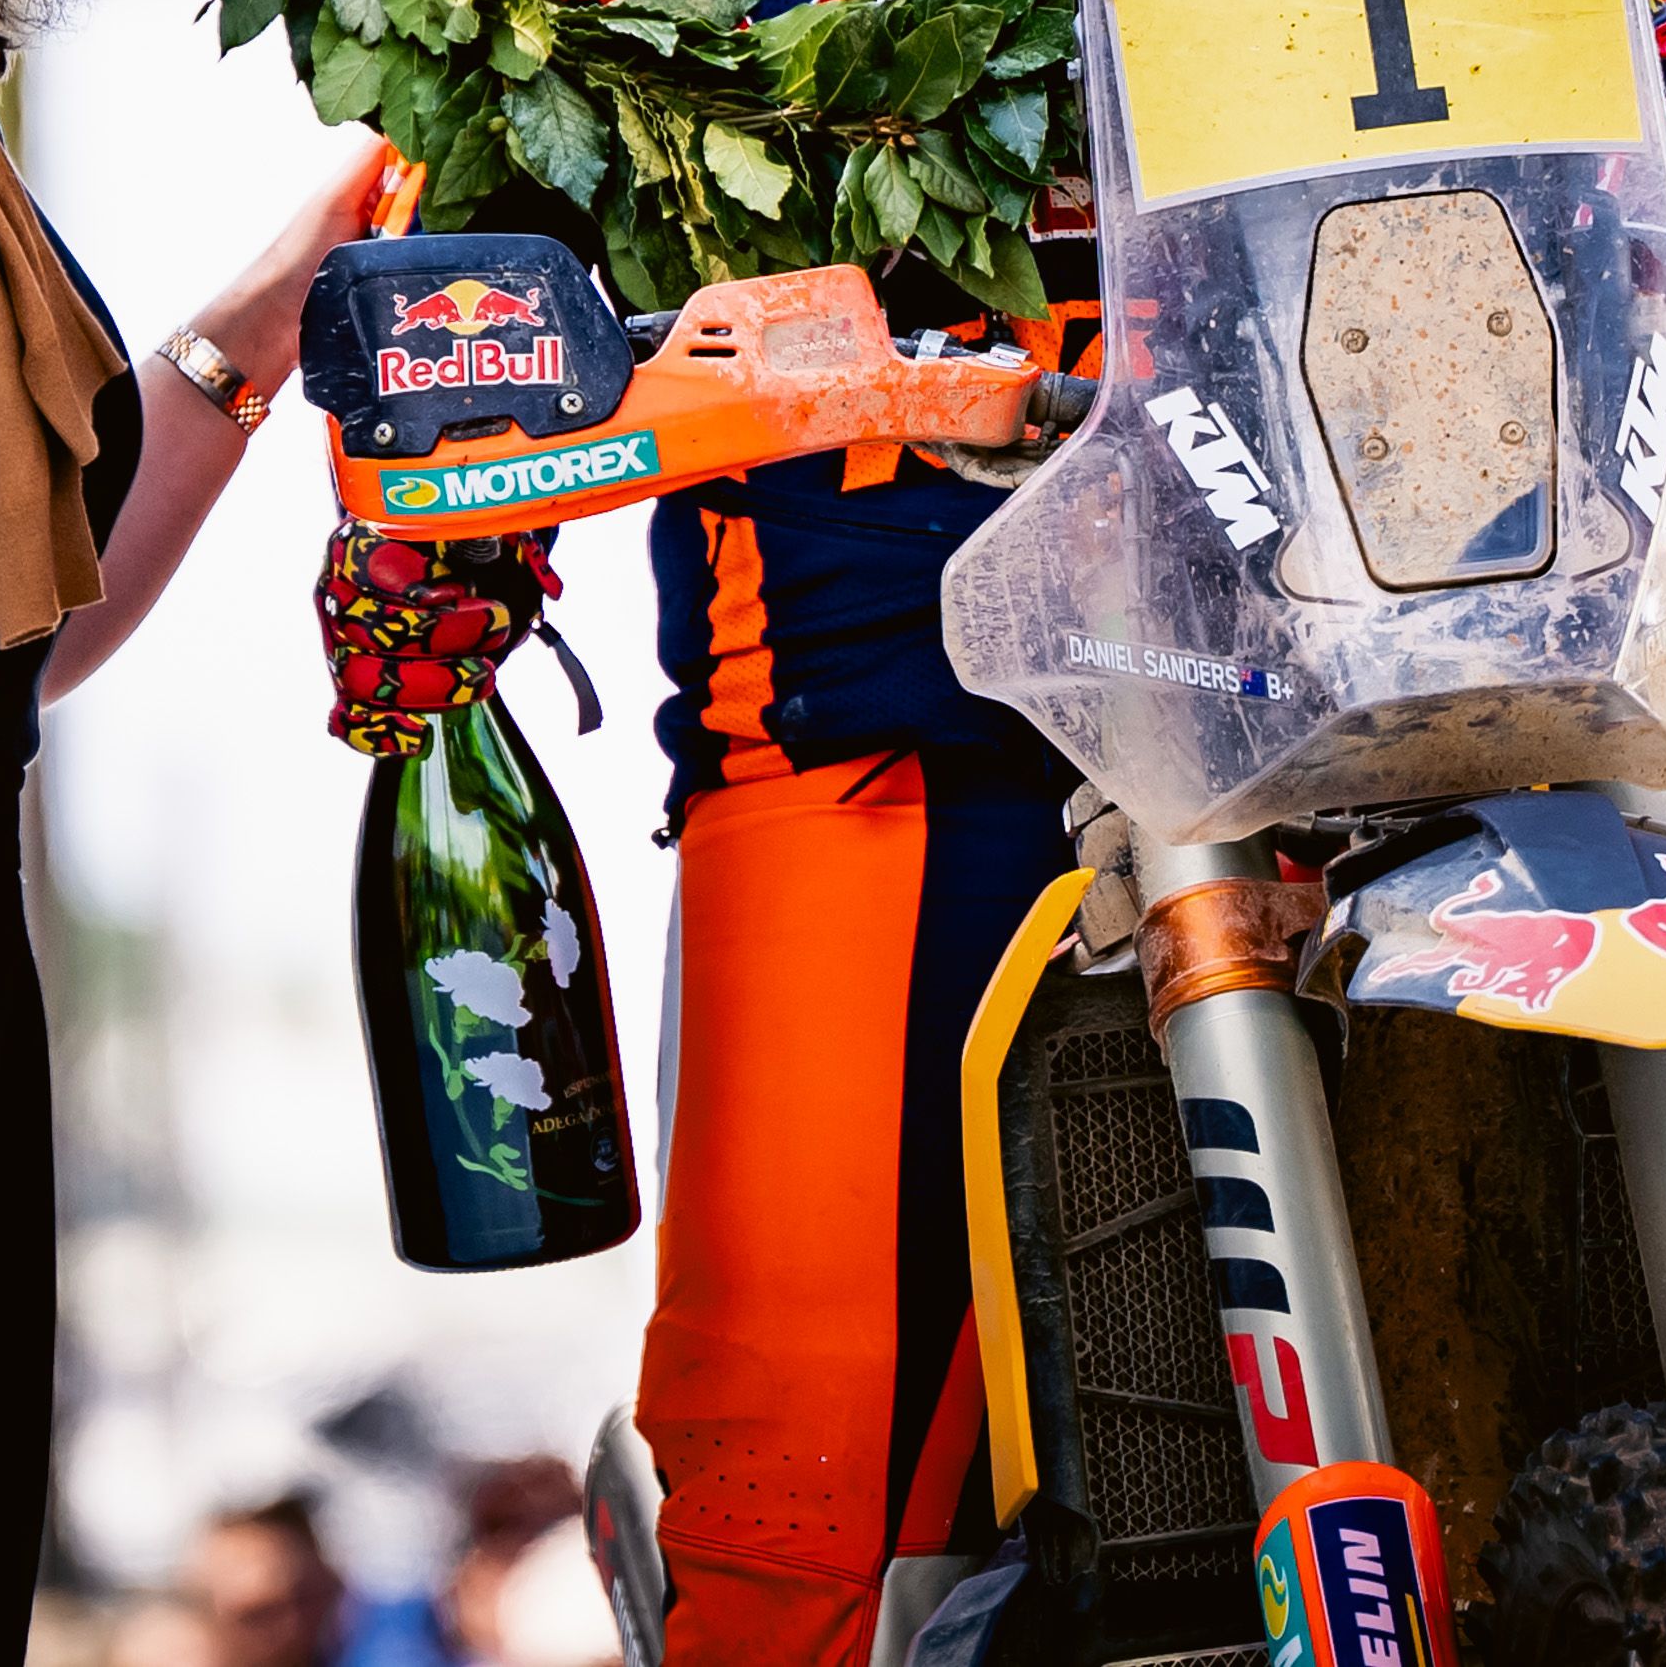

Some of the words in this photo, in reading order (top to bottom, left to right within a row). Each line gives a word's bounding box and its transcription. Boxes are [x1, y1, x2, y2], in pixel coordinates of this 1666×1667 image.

[377, 339, 468, 396] Red
[471, 336, 563, 386] Bull
[443, 438, 648, 507] MOTOREX
[1144, 386, 1280, 551] KTM
[1069, 635, 1140, 675] DANIEL
[1143, 650, 1241, 694] SANDERS
[1266, 673, 1294, 701] B+
